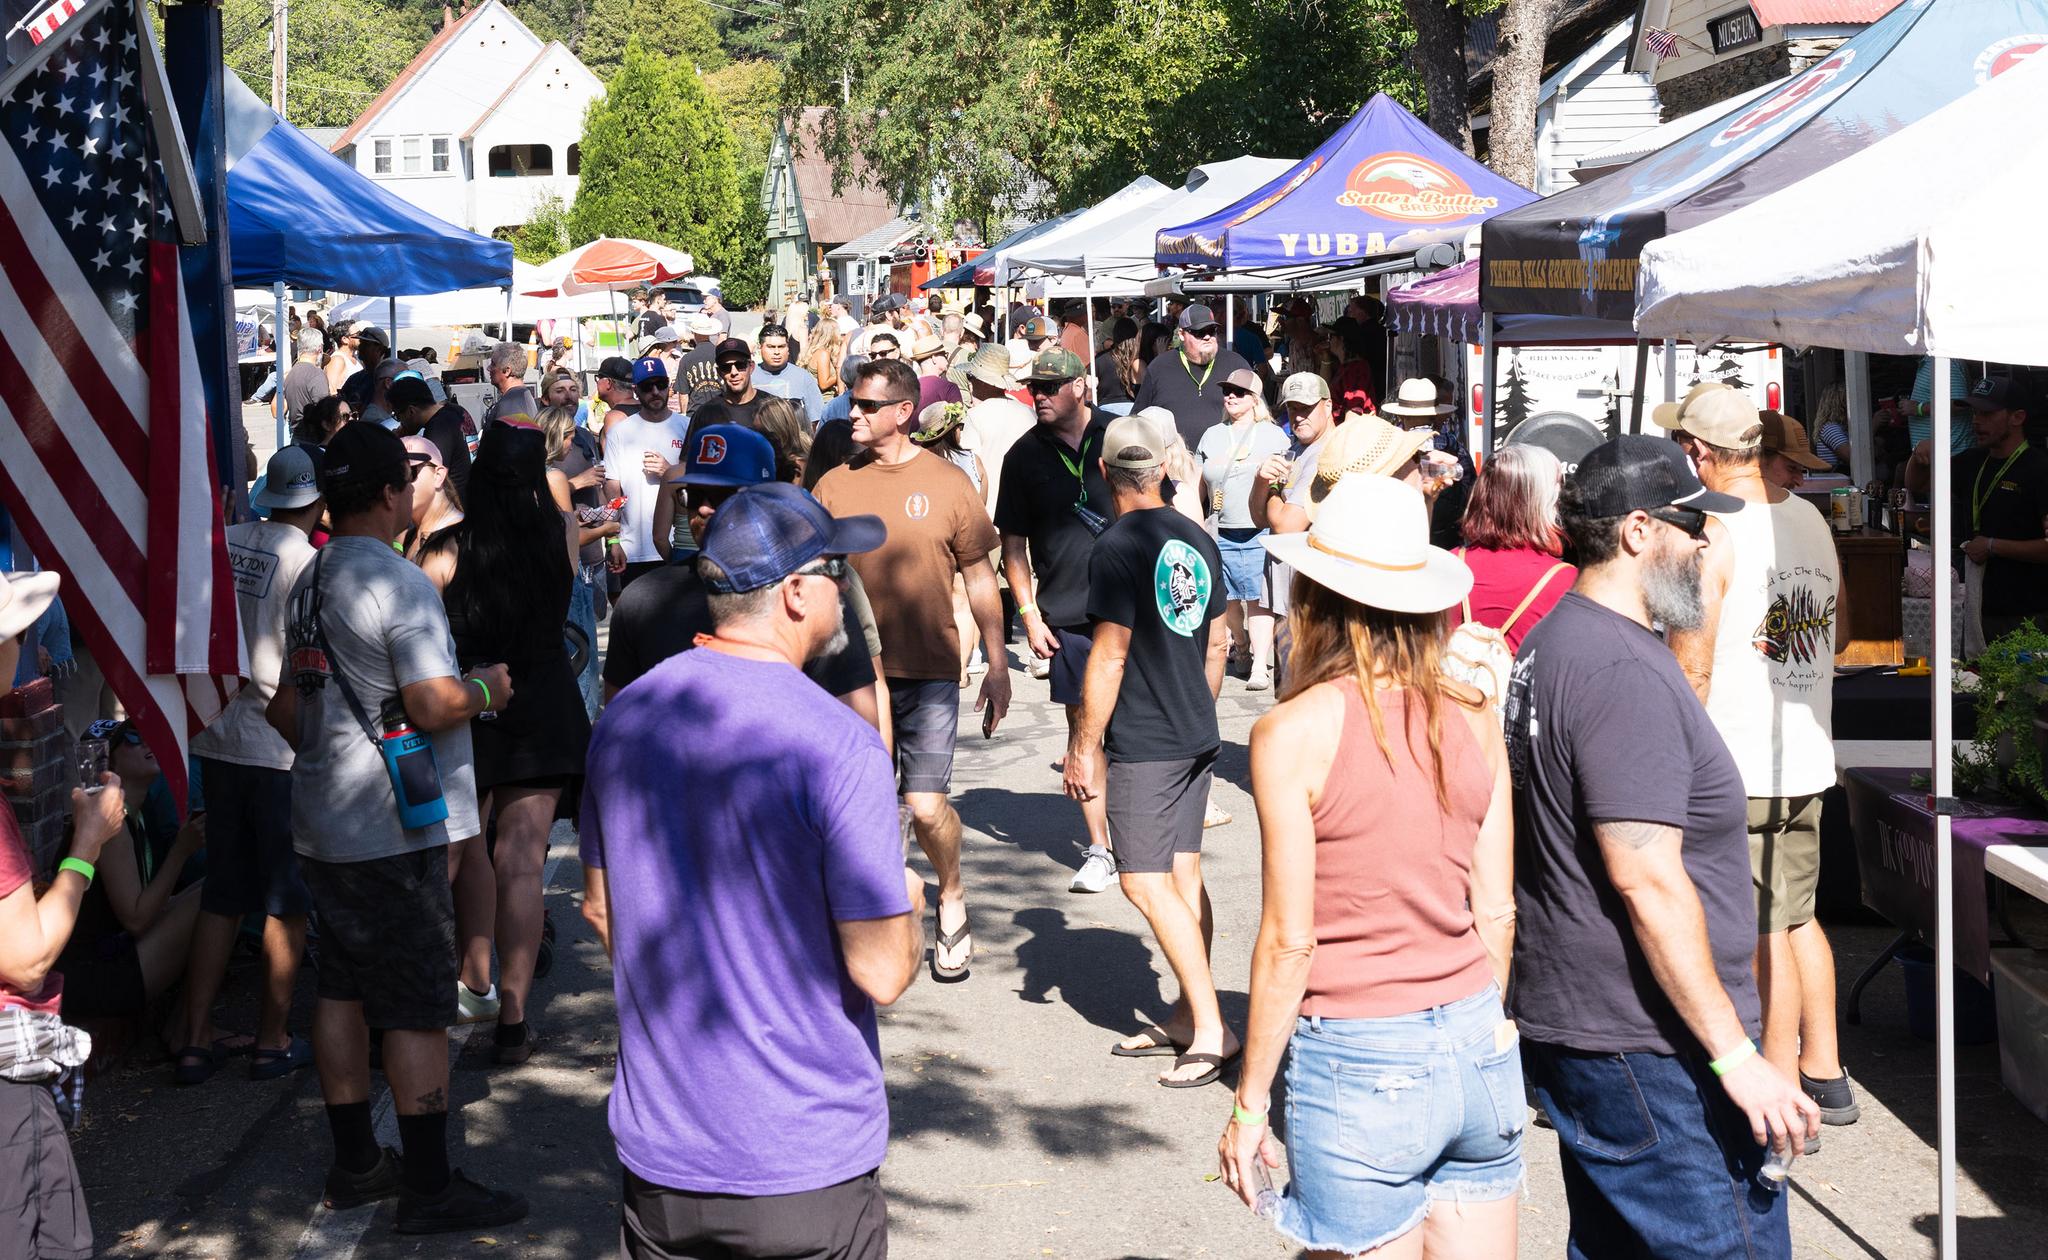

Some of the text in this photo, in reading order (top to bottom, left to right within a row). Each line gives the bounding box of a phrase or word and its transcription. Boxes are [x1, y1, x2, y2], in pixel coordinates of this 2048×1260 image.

[1718, 14, 1757, 48] MUSEUM
[1337, 190, 1498, 208] Sutter Buttes
[1400, 203, 1485, 214] BREWING
[1278, 232, 1387, 256] YUBA
[1523, 260, 1547, 288] FALLS
[1548, 259, 1589, 289] BREWING
[643, 359, 655, 372] T
[1574, 369, 1597, 380] CLAIM
[1778, 570, 1792, 581] To
[1794, 566, 1812, 576] The
[1814, 567, 1832, 583] Bone
[1772, 678, 1786, 688] One
